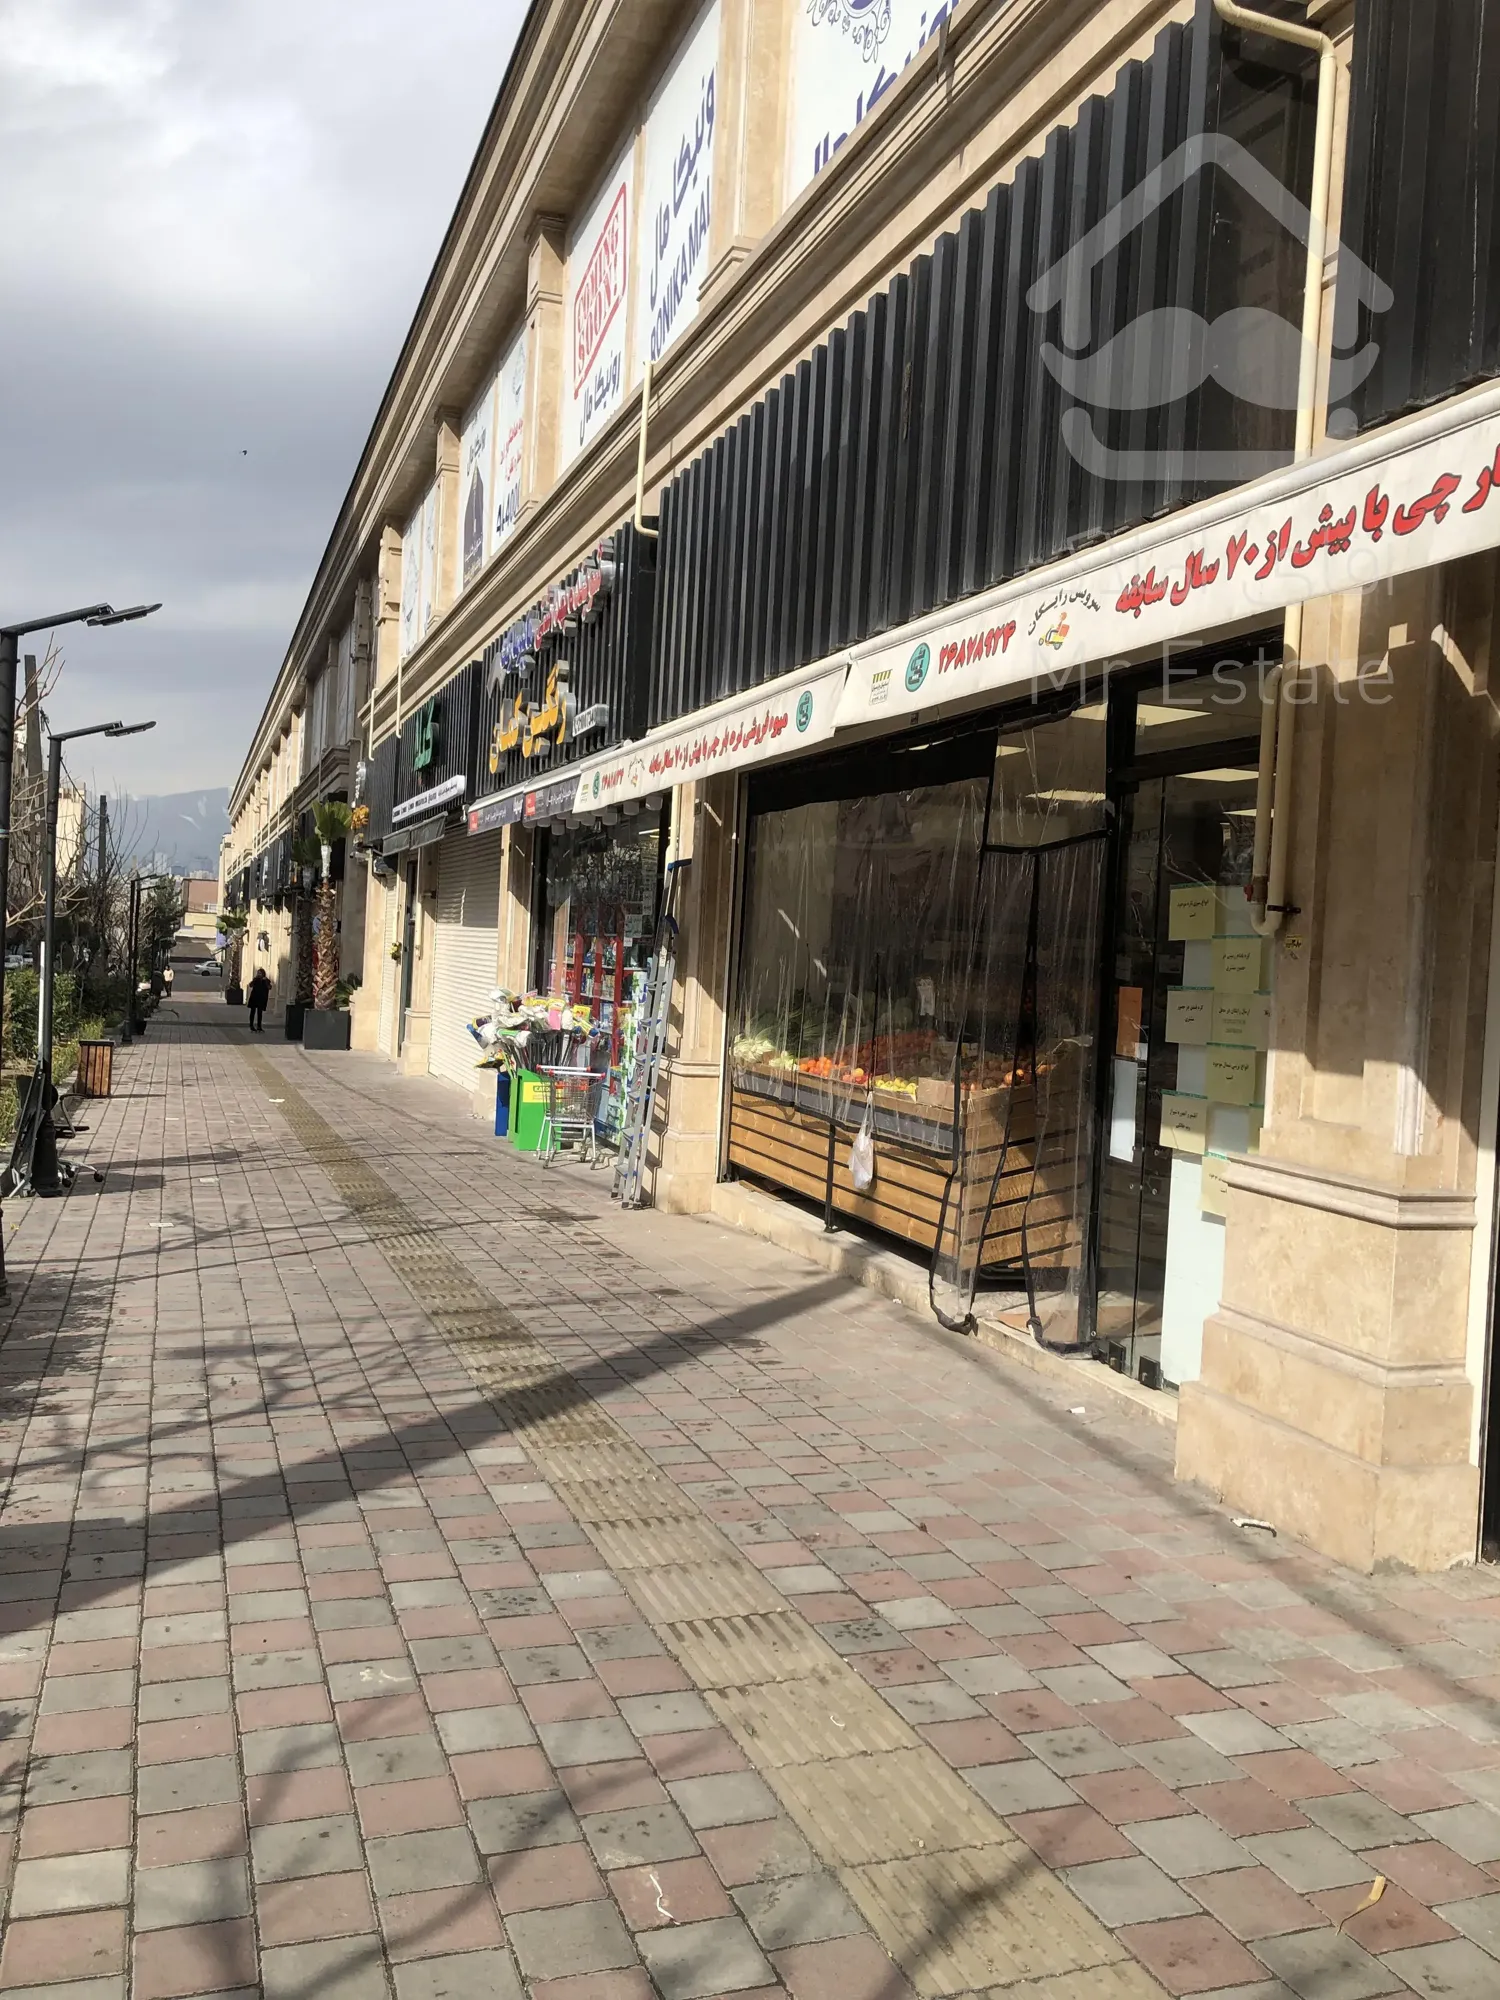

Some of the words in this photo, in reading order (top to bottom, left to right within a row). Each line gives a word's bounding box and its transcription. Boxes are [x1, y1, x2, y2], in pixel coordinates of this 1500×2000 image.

[674, 67, 715, 218] ونیکا
[577, 211, 619, 331] COMING
[650, 202, 670, 312] مال
[578, 252, 618, 375] SOON!
[651, 242, 688, 362] RONIKA
[595, 350, 621, 411] رونیکا
[579, 384, 593, 447] مال
[1291, 502, 1356, 569] بیش
[1361, 483, 1389, 542] با
[1170, 546, 1220, 606] سال
[1226, 529, 1260, 580] ۷۰
[1255, 516, 1292, 580] از
[1069, 588, 1100, 613] سرویس
[1115, 564, 1168, 618] سابقه
[689, 739, 701, 767] بیش
[743, 709, 770, 749] فروشی
[769, 712, 788, 739] میوه
[660, 748, 674, 775] سال
